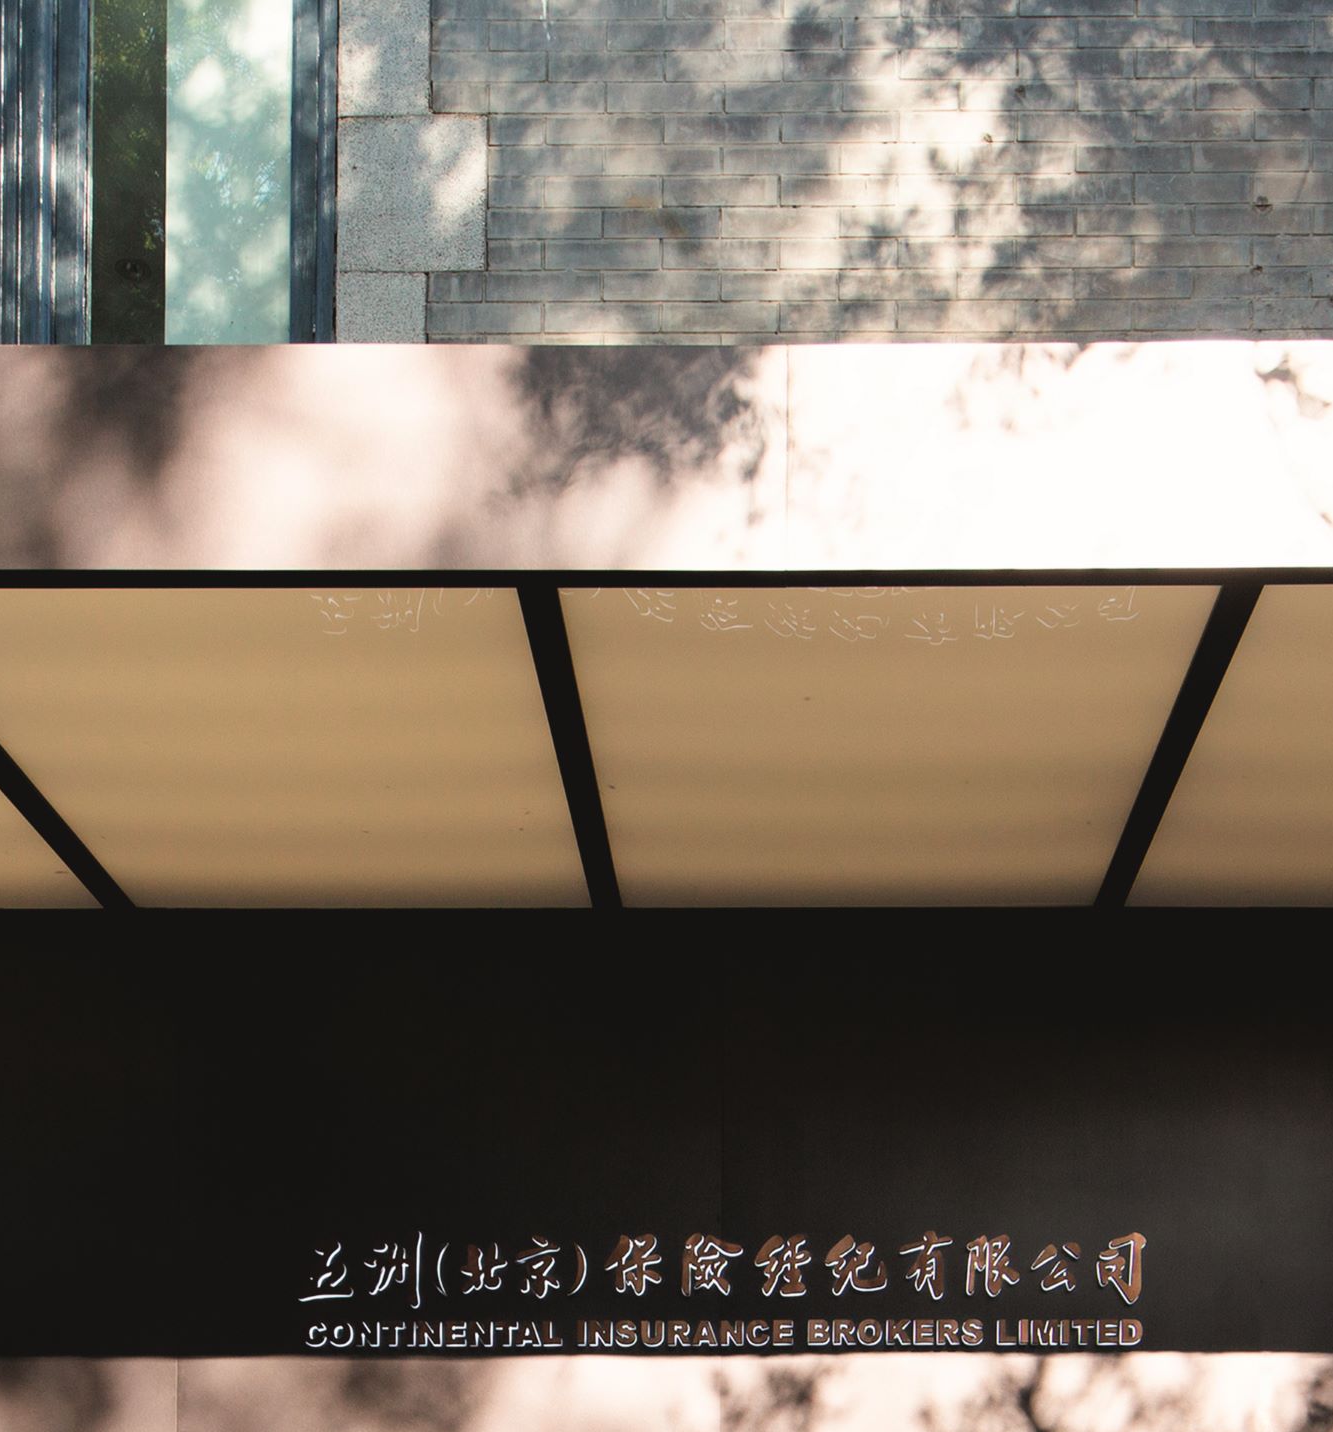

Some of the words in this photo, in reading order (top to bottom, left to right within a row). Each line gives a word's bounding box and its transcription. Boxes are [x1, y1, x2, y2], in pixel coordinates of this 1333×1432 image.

[305, 1320, 563, 1348] CONTINENTAL
[576, 1319, 794, 1348] INSURANCE
[807, 1318, 984, 1347] BROKERS
[995, 1318, 1144, 1347] LIMITED
